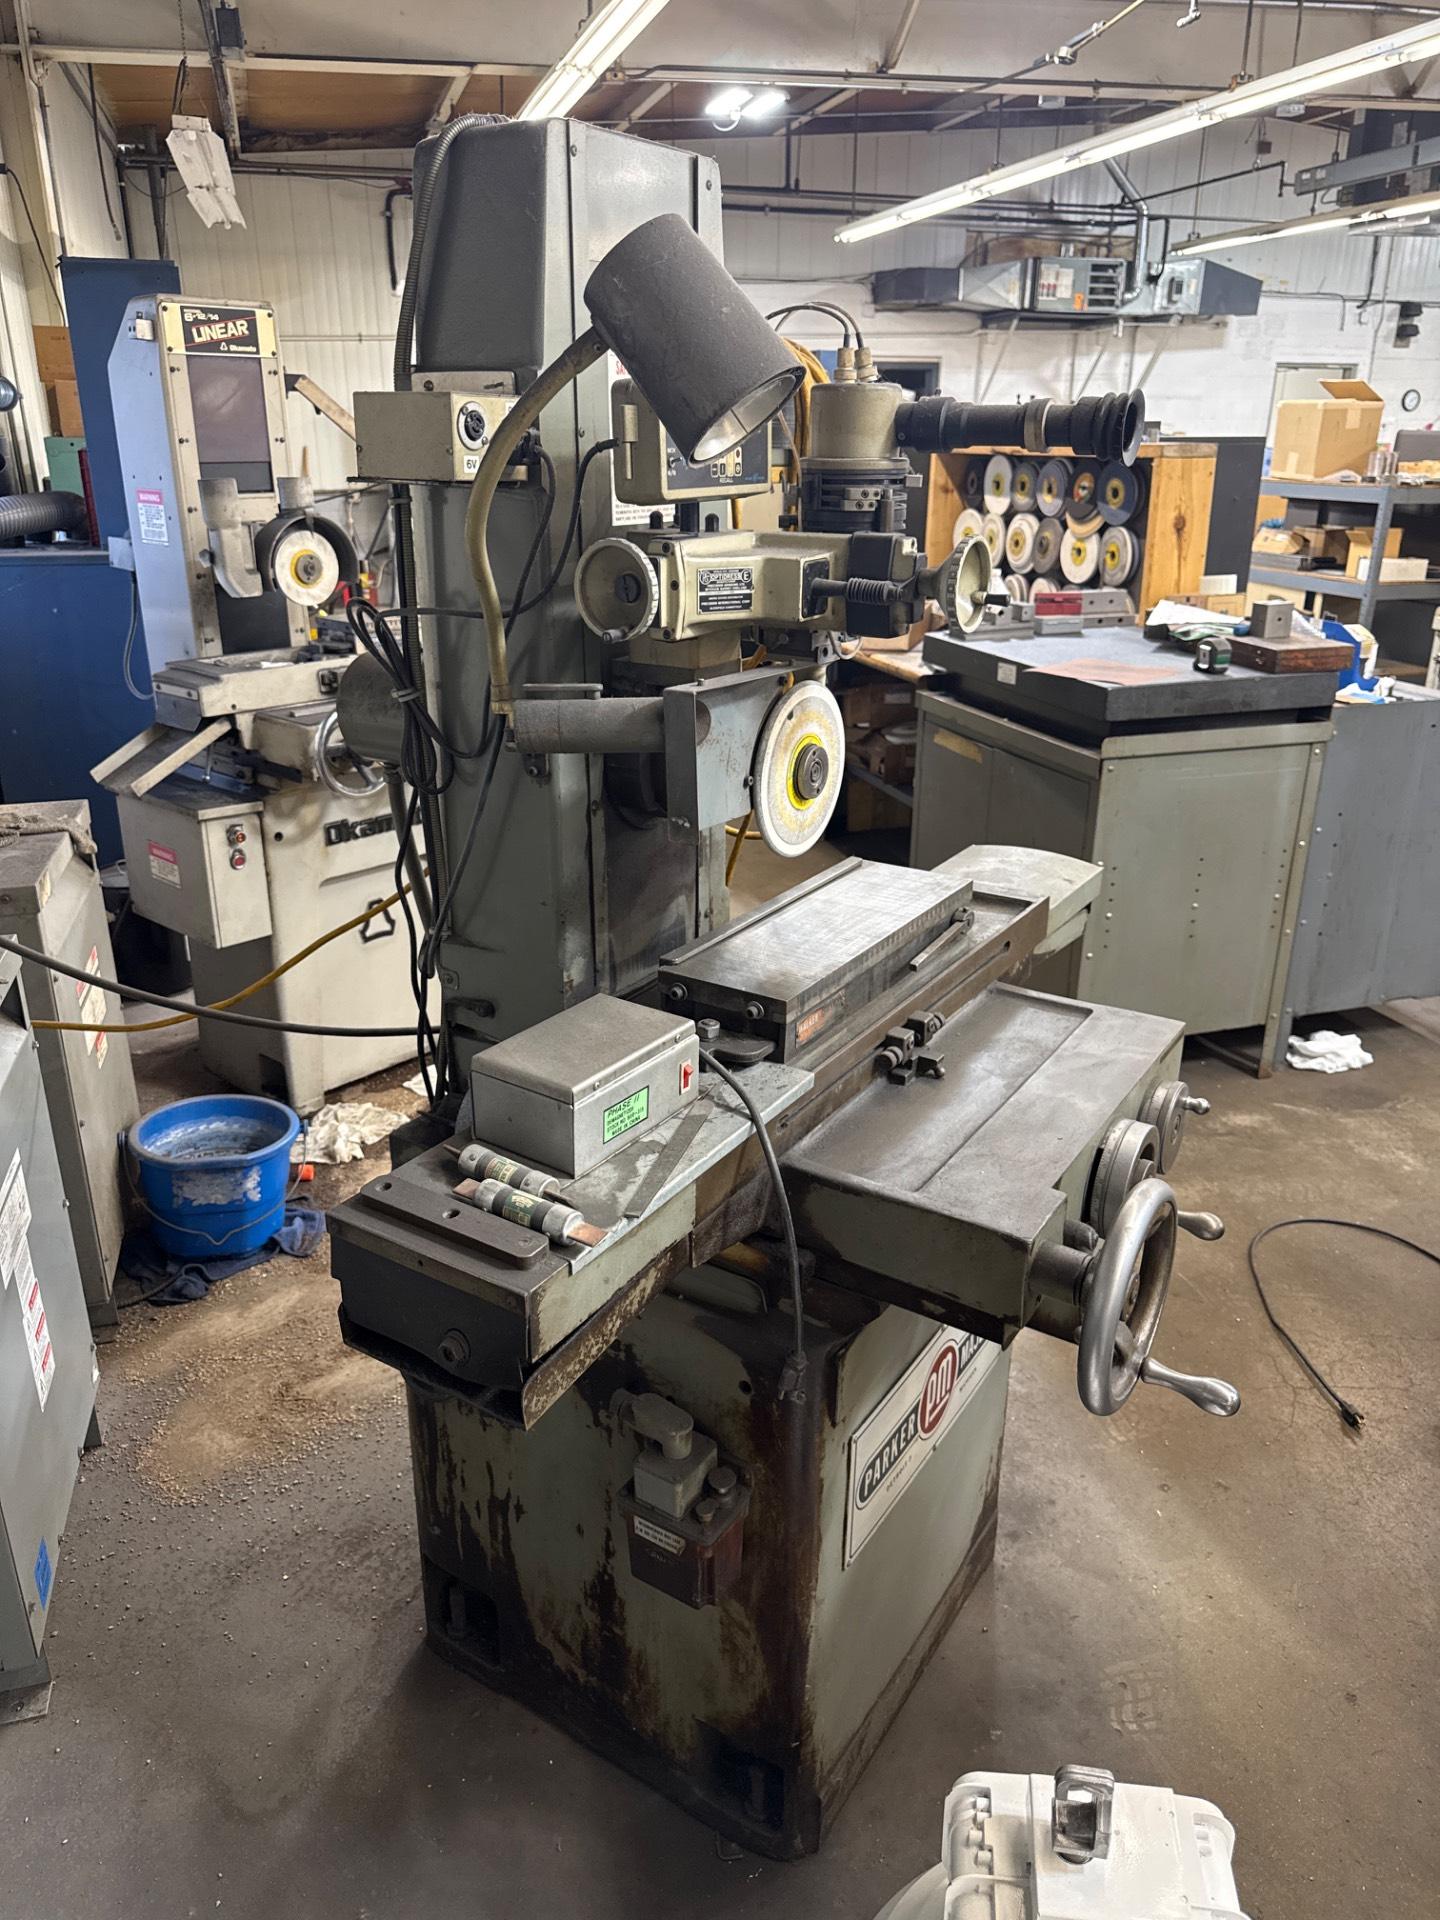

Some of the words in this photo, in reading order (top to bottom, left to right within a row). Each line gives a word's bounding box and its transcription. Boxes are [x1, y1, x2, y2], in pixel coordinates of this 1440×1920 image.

[191, 320, 249, 343] LINEAR
[466, 459, 477, 469] 6V
[607, 1099, 632, 1118] PHASE
[863, 1412, 917, 1497] PARKER
